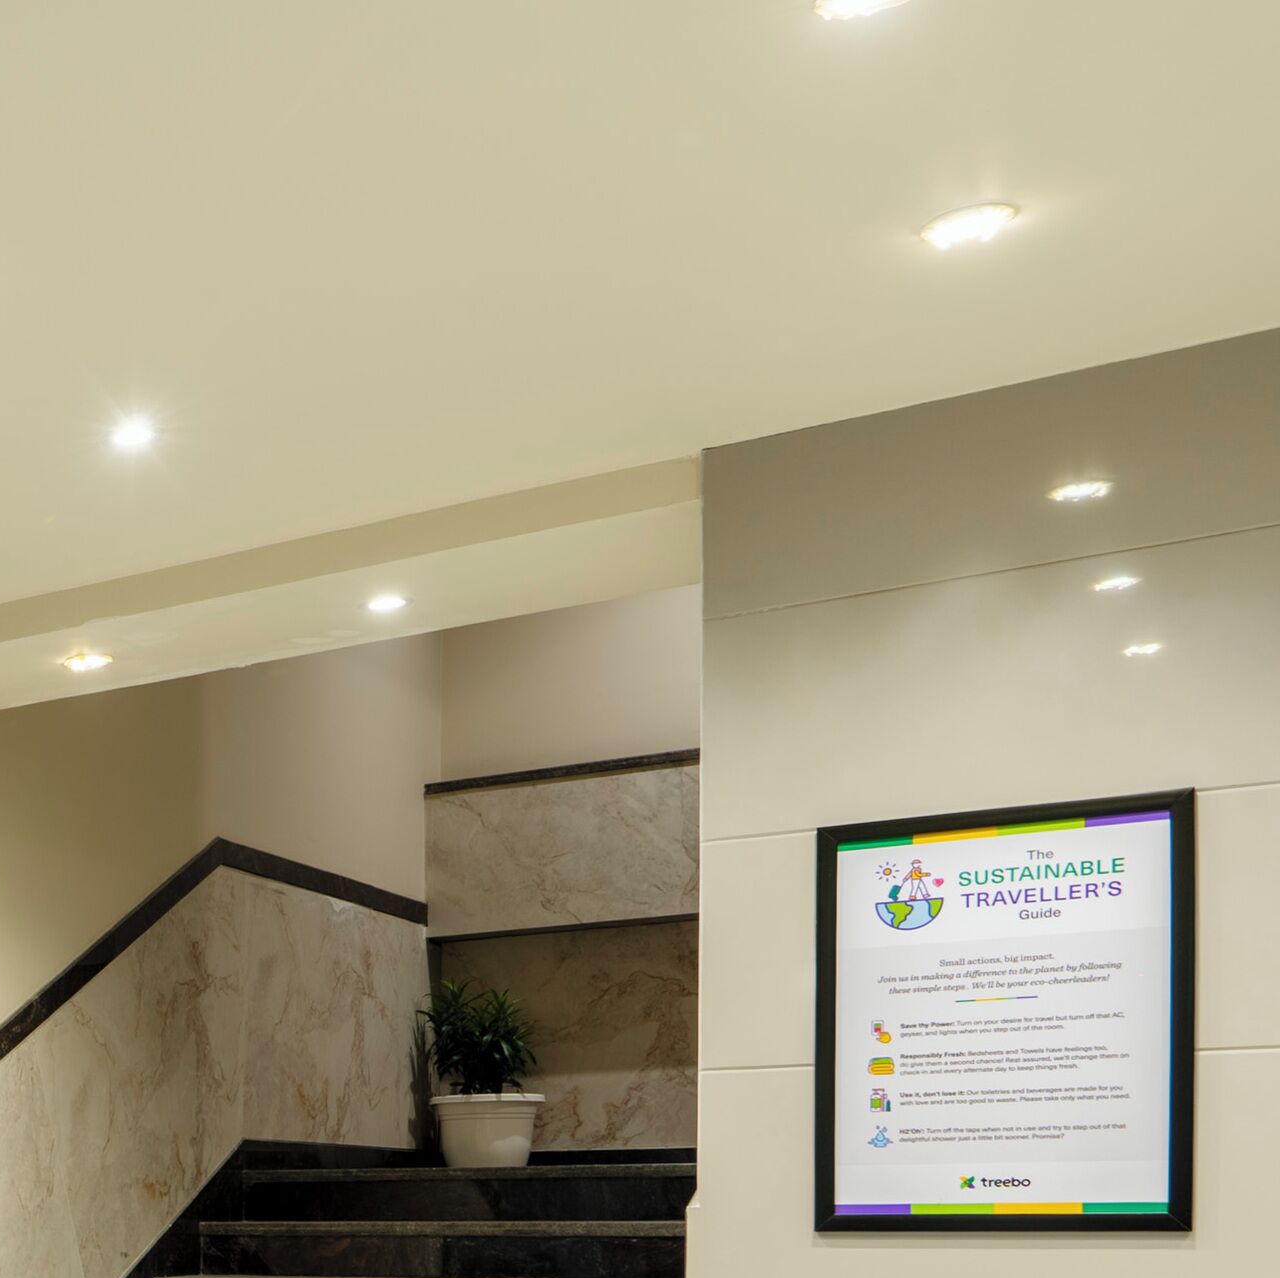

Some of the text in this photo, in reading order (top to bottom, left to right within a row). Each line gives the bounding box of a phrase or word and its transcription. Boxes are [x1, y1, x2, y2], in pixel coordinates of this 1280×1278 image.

[1027, 850, 1054, 860] The
[958, 858, 1125, 887] SUSTAINABLE
[961, 881, 1122, 908] TRAVELLER'S
[1019, 908, 1062, 920] Guide
[939, 958, 965, 967] Small
[1004, 955, 1019, 963] big
[877, 976, 897, 984] Join
[921, 972, 955, 981] making
[962, 970, 1007, 979] difference
[1019, 966, 1033, 974] the
[1034, 965, 1064, 975] planet
[1077, 961, 1122, 972] following
[981, 1177, 1031, 1187] treebo
